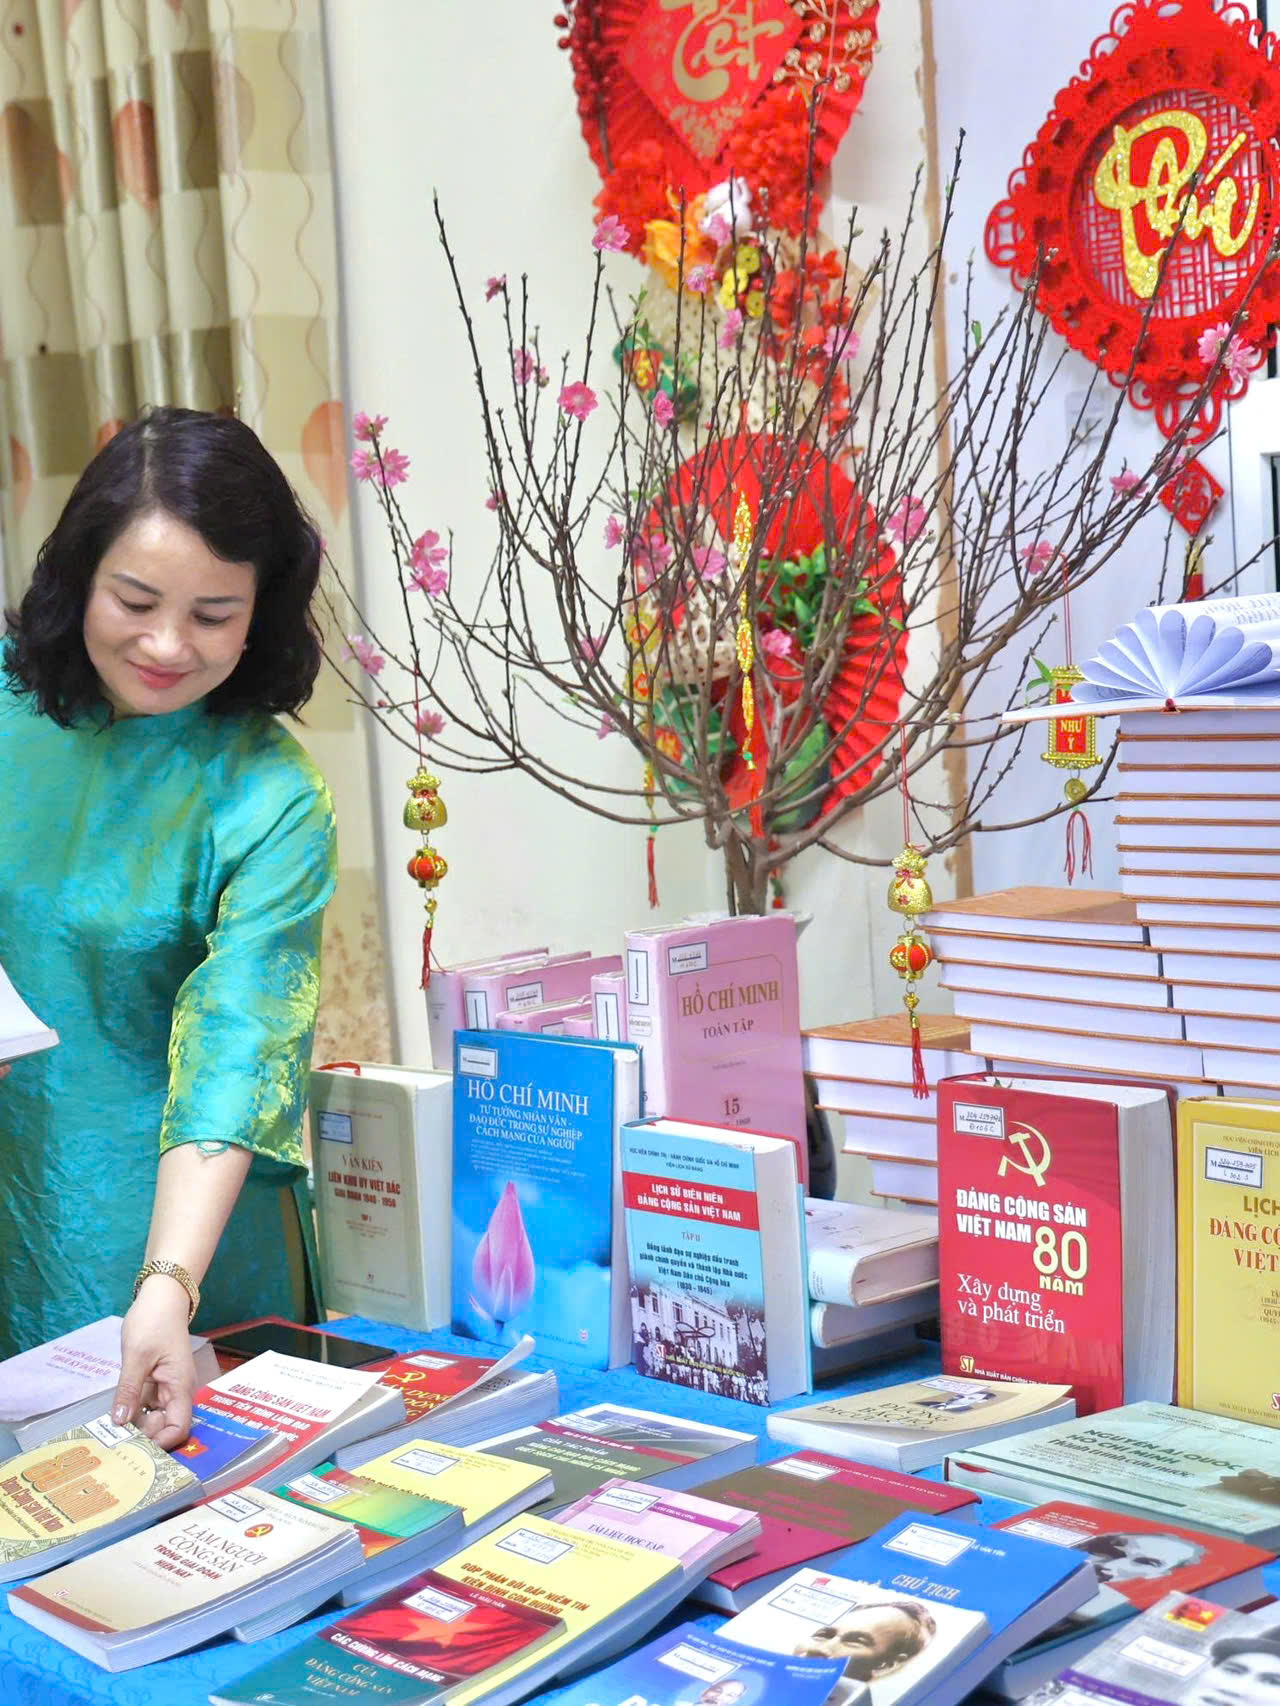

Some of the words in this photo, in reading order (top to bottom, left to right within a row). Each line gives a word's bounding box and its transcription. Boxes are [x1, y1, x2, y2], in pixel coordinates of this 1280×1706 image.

[1094, 110, 1261, 298] Phú
[681, 982, 705, 1017] HỒ
[707, 983, 734, 1012] CHÍ
[738, 980, 780, 1007] MINH
[467, 1077, 495, 1101] HỒ
[499, 1081, 534, 1108] CHÍ
[536, 1089, 590, 1117] MINH
[723, 1097, 741, 1116] 15
[508, 1119, 538, 1134] TRONG
[637, 1192, 660, 1208] ĐẢNG
[660, 1197, 682, 1211] CỘNG
[683, 1200, 701, 1215] SẢN
[701, 1204, 721, 1219] VIỆT
[721, 1208, 741, 1222] NAM
[651, 1183, 669, 1196] LỊCH
[669, 1184, 681, 1197] SỬ
[682, 1187, 702, 1201] BIÊN
[703, 1191, 724, 1205] NIÊN
[956, 1186, 1001, 1215] ĐẢNG
[1004, 1195, 1050, 1222] CỘNG
[1053, 1201, 1087, 1228] SẢN
[956, 1213, 992, 1238] VIỆT
[995, 1221, 1032, 1244] NAM
[1210, 1215, 1258, 1241] ĐẢNG
[1032, 1225, 1088, 1281] 80
[1233, 1248, 1280, 1274] VIỆT
[957, 1273, 993, 1300] Xây
[998, 1282, 1041, 1312] dựng
[1038, 1273, 1085, 1297] NĂM
[957, 1298, 978, 1317] và
[982, 1301, 1020, 1326] phát
[1025, 1307, 1066, 1335] triển
[308, 1407, 333, 1418] NAM
[1128, 1448, 1180, 1466] MINH
[153, 1544, 183, 1561] TRONG
[180, 1558, 200, 1569] GIAI
[168, 1535, 215, 1561] CỘNG
[182, 1523, 222, 1548] LÀM
[220, 1539, 268, 1566] NGƯỜI
[173, 1567, 194, 1578] NAY
[461, 1562, 483, 1574] GÓP
[480, 1569, 508, 1584] PHẦN
[571, 1600, 591, 1611] TIN
[508, 1592, 531, 1604] CON
[891, 1573, 929, 1591] CHỦ
[922, 1581, 960, 1600] TỊCH
[330, 1631, 354, 1646] CÁC
[348, 1639, 380, 1658] CƯƠNG
[393, 1659, 422, 1674] CÁCH
[416, 1669, 446, 1683] MẠNG
